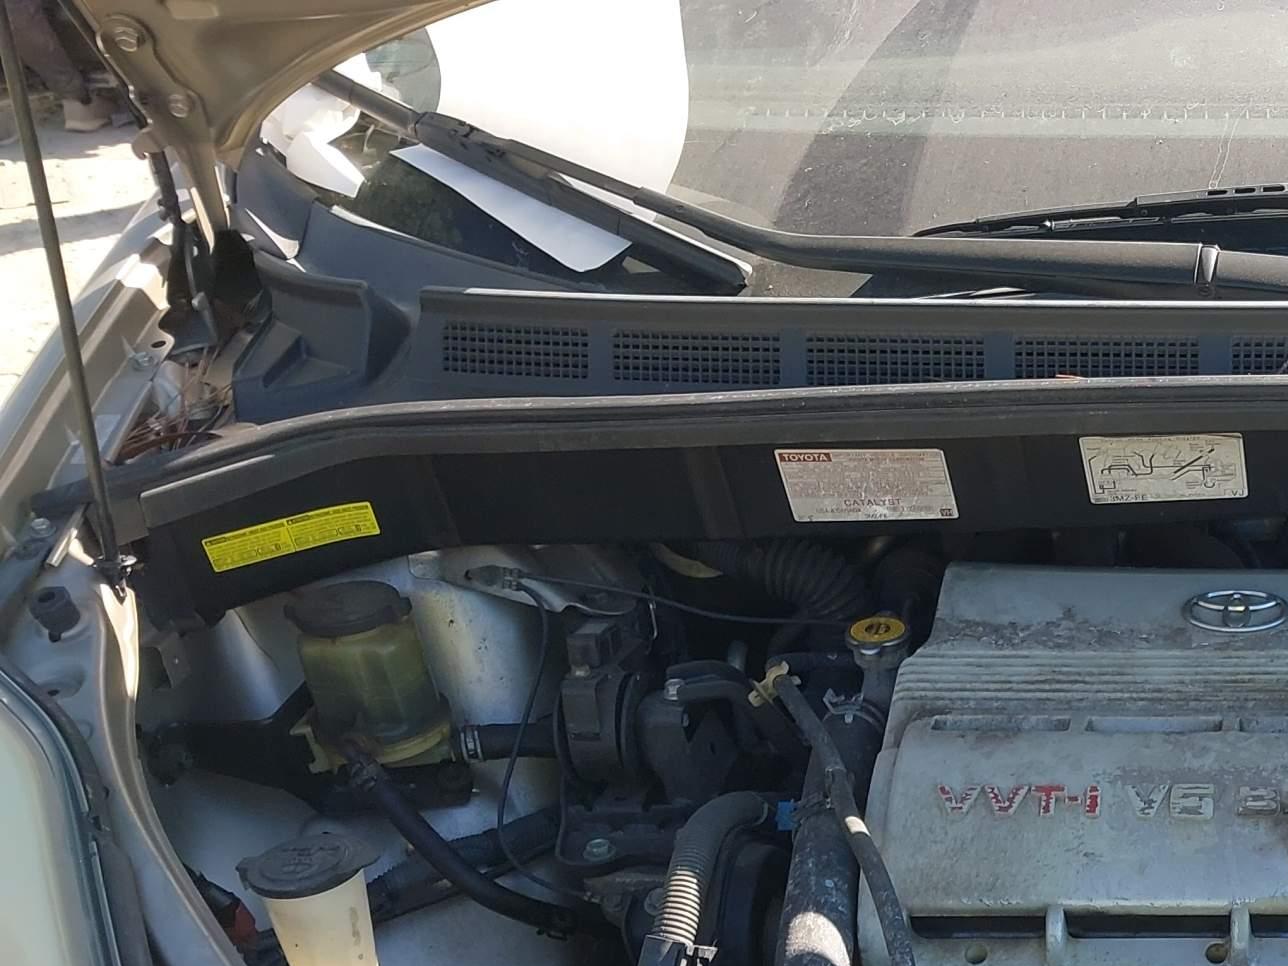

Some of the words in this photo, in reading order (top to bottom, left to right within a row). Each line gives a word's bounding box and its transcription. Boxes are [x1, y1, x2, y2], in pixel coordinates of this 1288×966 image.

[782, 453, 827, 462] TOYOTA
[843, 498, 901, 507] CATALYST
[1128, 782, 1216, 820] V6
